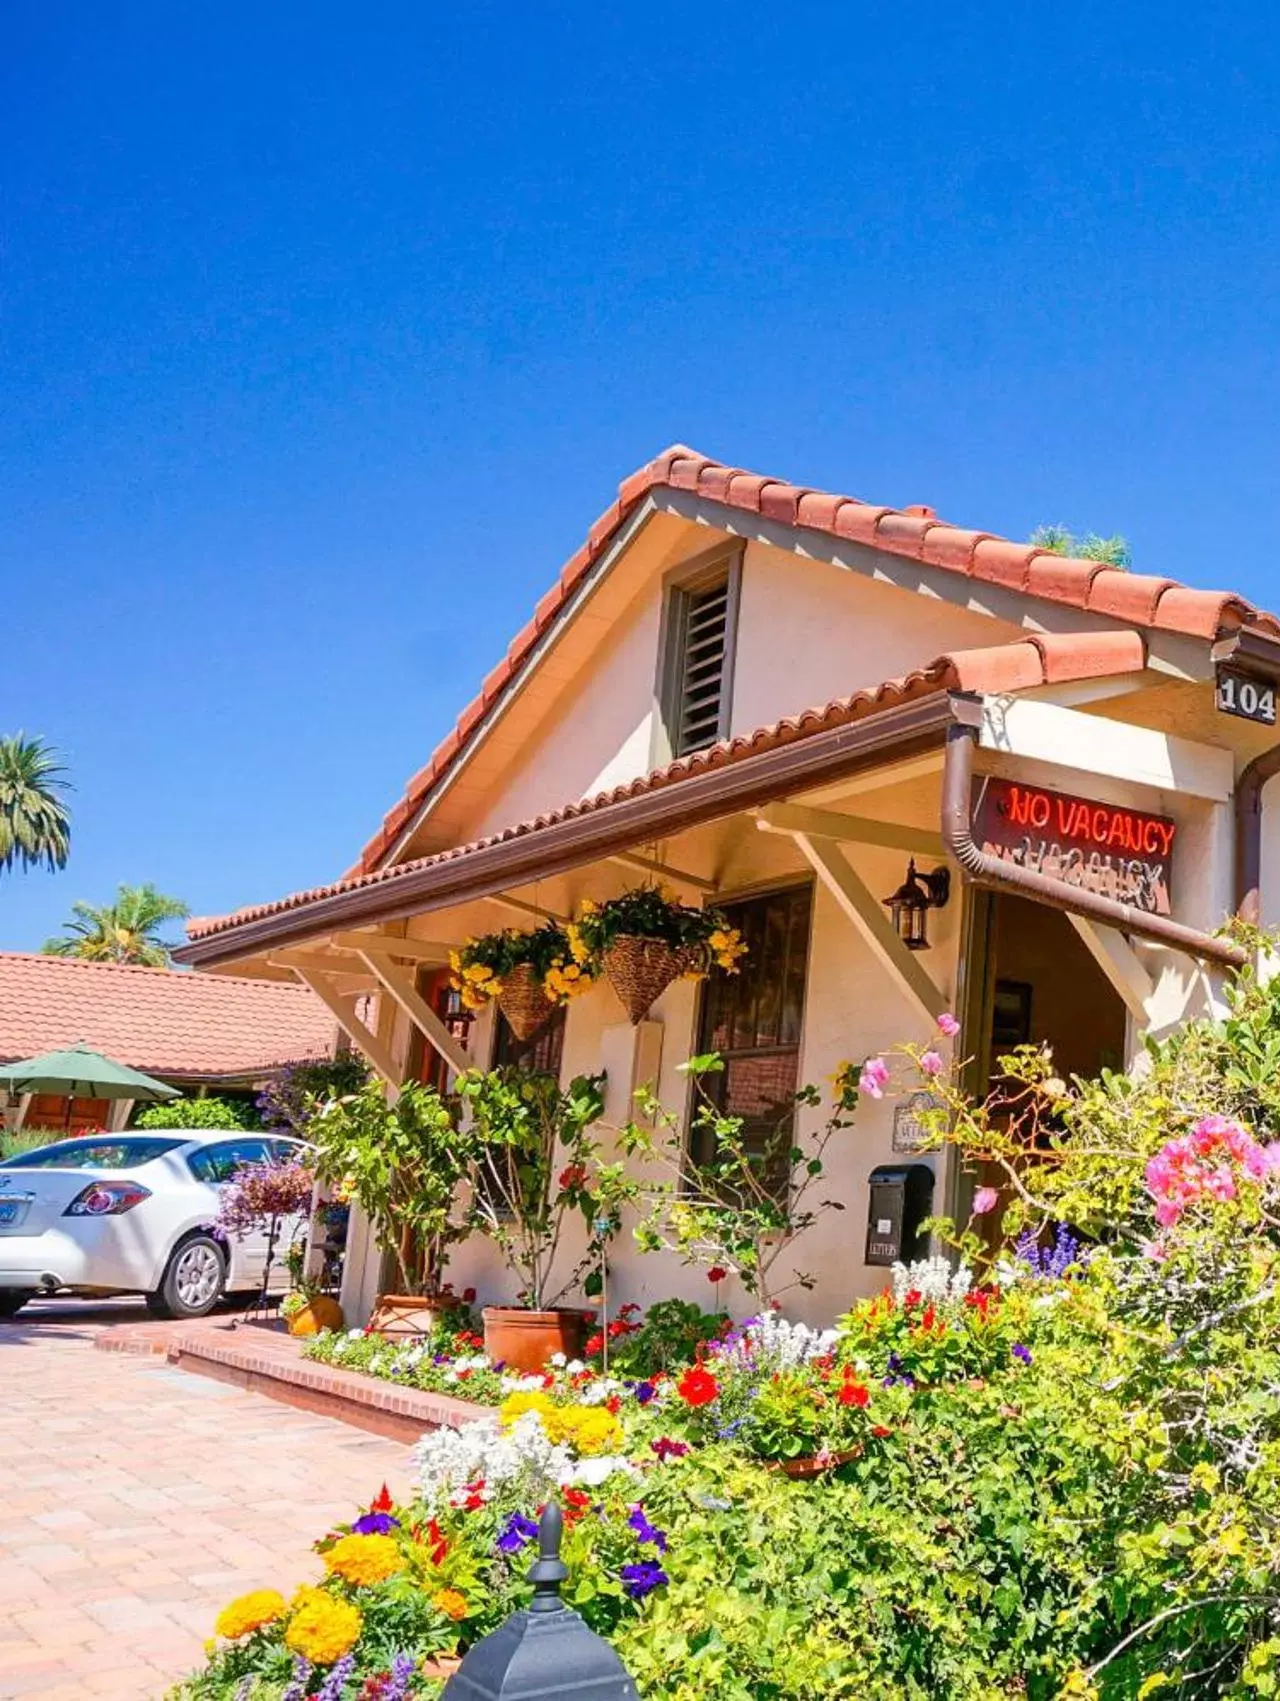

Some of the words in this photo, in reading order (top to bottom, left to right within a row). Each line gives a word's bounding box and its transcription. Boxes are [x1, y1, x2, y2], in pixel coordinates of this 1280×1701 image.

[1219, 678, 1275, 720] 104
[1010, 786, 1050, 827] NO
[1057, 799, 1175, 856] VACANCY
